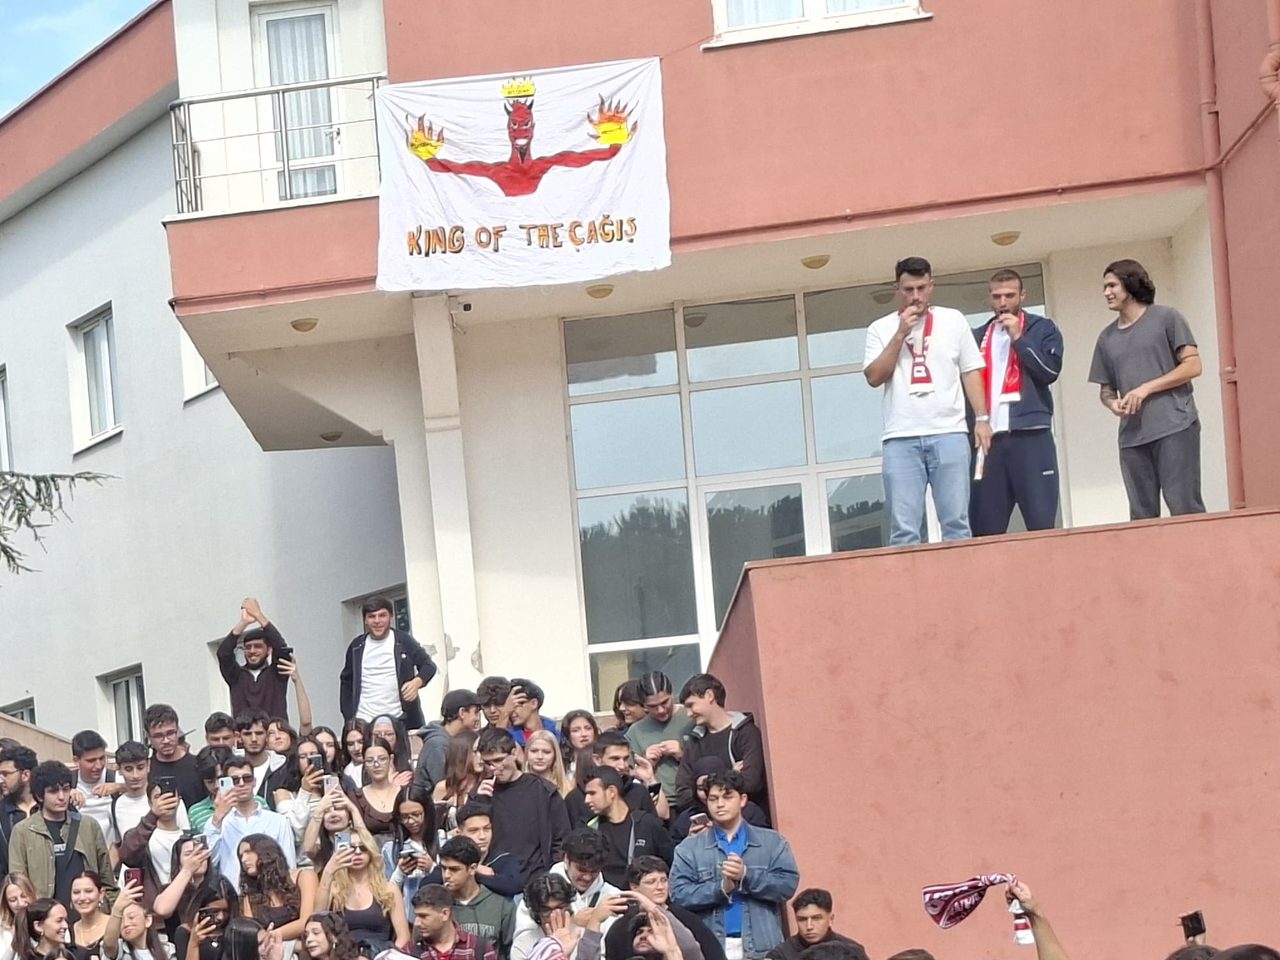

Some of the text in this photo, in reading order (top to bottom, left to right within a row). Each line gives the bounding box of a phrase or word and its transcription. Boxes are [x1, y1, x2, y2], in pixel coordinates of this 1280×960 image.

[407, 224, 464, 257] KING
[475, 225, 507, 252] OF
[519, 223, 564, 248] THE
